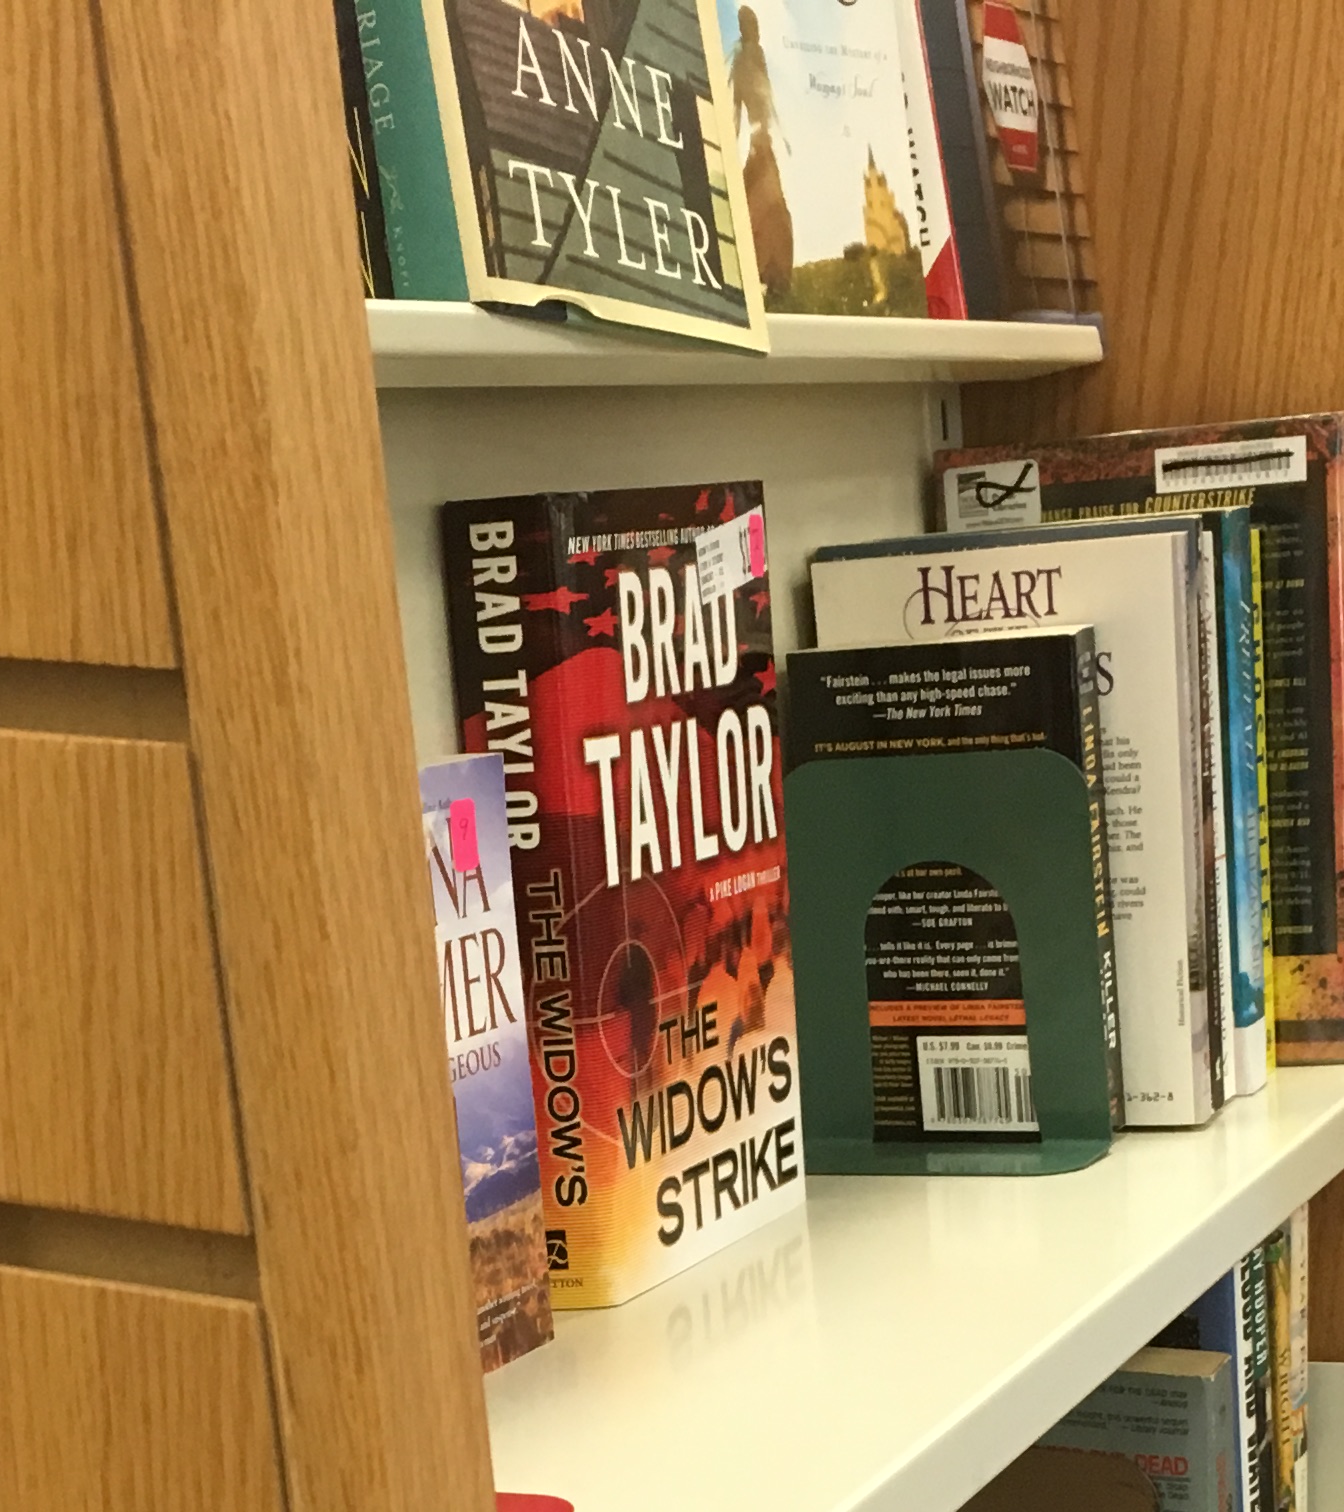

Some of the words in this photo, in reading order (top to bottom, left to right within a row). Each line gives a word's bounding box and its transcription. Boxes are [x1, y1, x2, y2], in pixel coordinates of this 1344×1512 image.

[511, 16, 684, 150] ANNE
[988, 81, 1036, 117] WATCH
[508, 159, 723, 290] TYLER
[1145, 487, 1256, 513] COUNTERSTRIKE
[568, 536, 591, 555] NEW
[592, 533, 613, 552] YORK
[614, 531, 635, 551] TIMES
[635, 527, 679, 549] BESTSELLING
[468, 519, 524, 655] BRAD
[916, 565, 1062, 625] HEART
[618, 565, 739, 704] BRAD
[835, 691, 875, 706] exciting
[876, 689, 899, 703] than
[900, 690, 918, 703] any
[889, 673, 922, 685] makes
[923, 670, 940, 683] the
[941, 668, 967, 683] legal
[968, 666, 1001, 680] issues
[1003, 665, 1031, 678] more
[906, 707, 927, 719] New
[929, 705, 951, 718] York
[954, 703, 983, 717] Times
[482, 669, 542, 850] TAYLOR
[835, 740, 875, 752] AUGUST
[876, 740, 888, 750] IN
[889, 738, 914, 749] NEW
[1082, 706, 1097, 788] LINDA
[582, 704, 779, 889] TAYLOR
[715, 880, 733, 901] PIKE
[733, 872, 756, 895] LOGAN
[756, 866, 781, 886] THRILLER
[1089, 801, 1111, 938] FAIRSTEIN
[526, 869, 569, 983] THE
[938, 917, 973, 928] GRAFTON
[950, 981, 988, 992] CONNELLY
[1102, 950, 1117, 1050] KILLER
[658, 1001, 720, 1066] THE
[656, 1117, 799, 1247] STRIKE
[1135, 1454, 1189, 1475] DEAD
